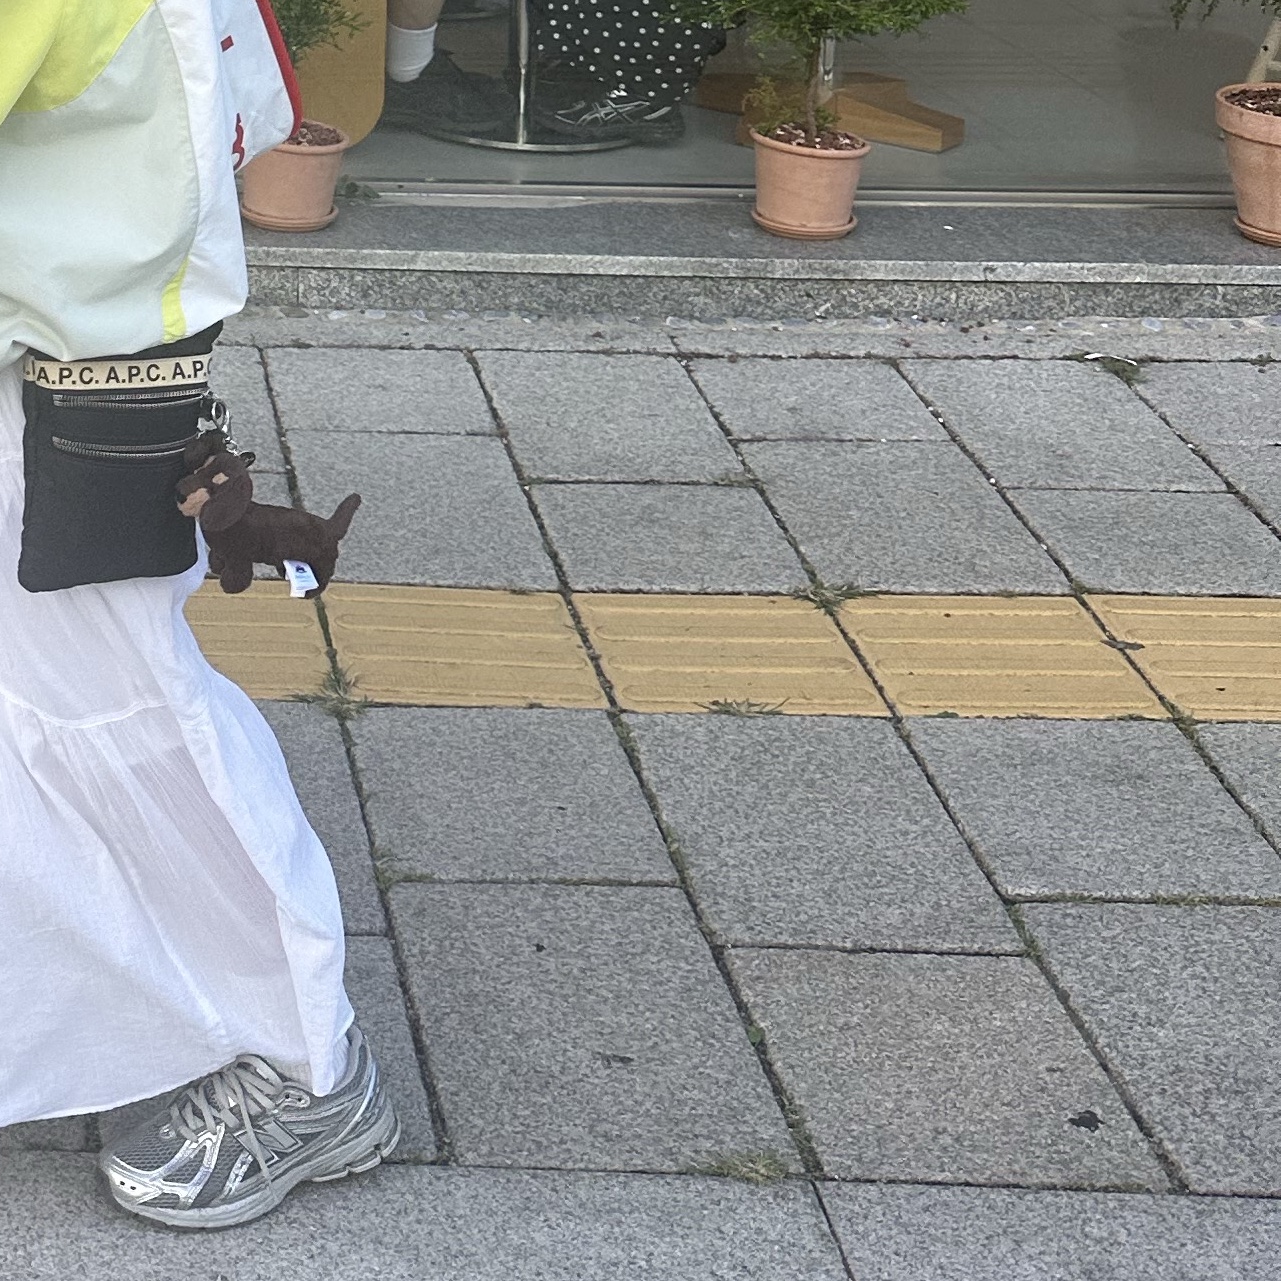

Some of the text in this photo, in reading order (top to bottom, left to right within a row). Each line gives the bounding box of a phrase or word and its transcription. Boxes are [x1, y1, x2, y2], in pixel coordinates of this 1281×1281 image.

[36, 366, 100, 386] A.P.C.
[107, 363, 167, 384] A.P.C.
[172, 360, 213, 381] A.P.
